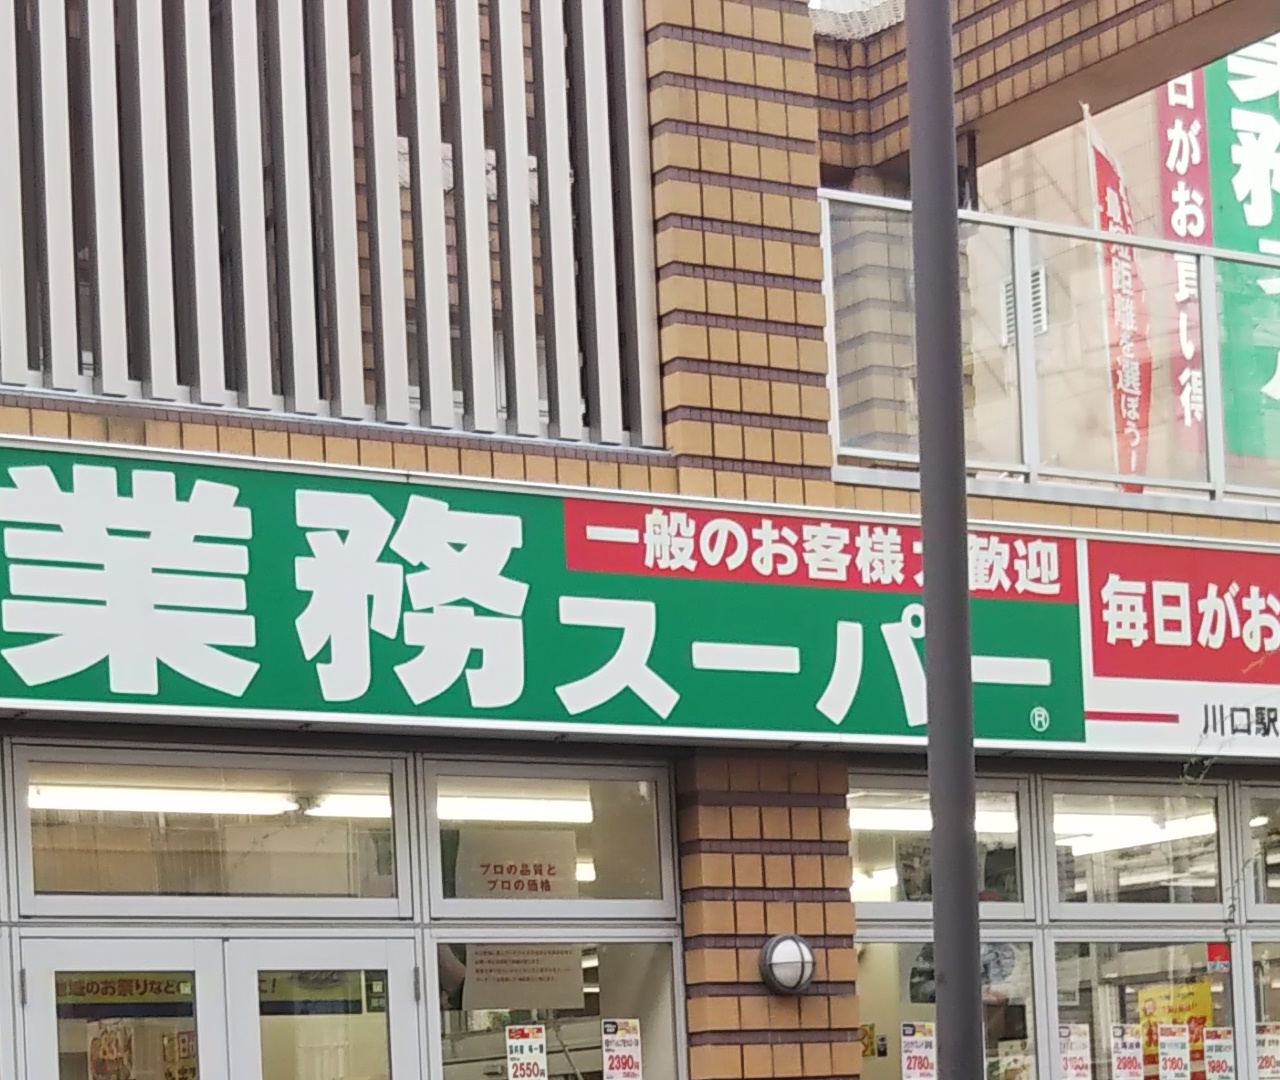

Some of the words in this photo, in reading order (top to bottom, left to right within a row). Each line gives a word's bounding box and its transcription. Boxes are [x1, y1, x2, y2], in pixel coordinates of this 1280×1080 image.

[586, 508, 1062, 597] 一般のお客様歓迎
[480, 863, 557, 877] プロの品質と
[488, 879, 552, 892] プロの価格
